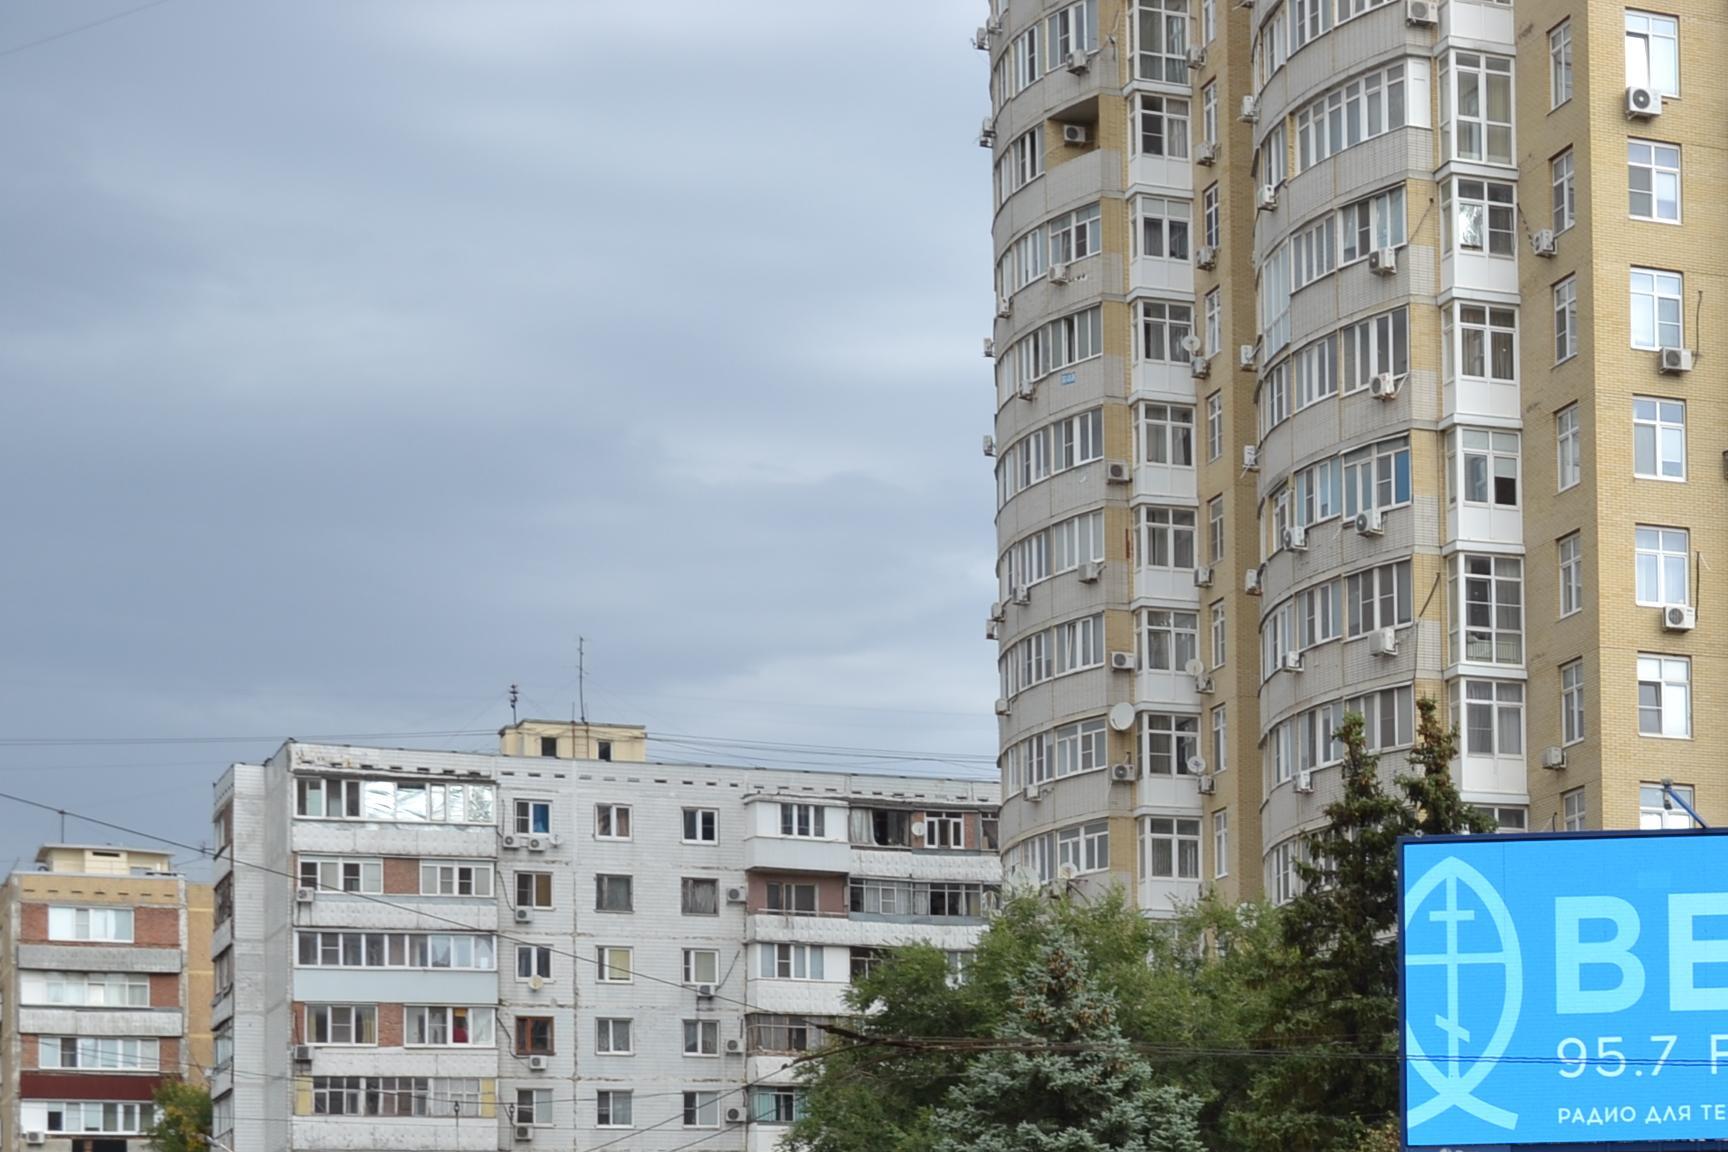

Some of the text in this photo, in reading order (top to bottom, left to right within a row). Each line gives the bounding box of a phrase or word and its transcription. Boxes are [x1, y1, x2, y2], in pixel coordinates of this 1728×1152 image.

[1556, 1035, 1677, 1078] 95.7
[1557, 1106, 1636, 1126] РАДИО
[1645, 1104, 1692, 1124] ДЛЯ
